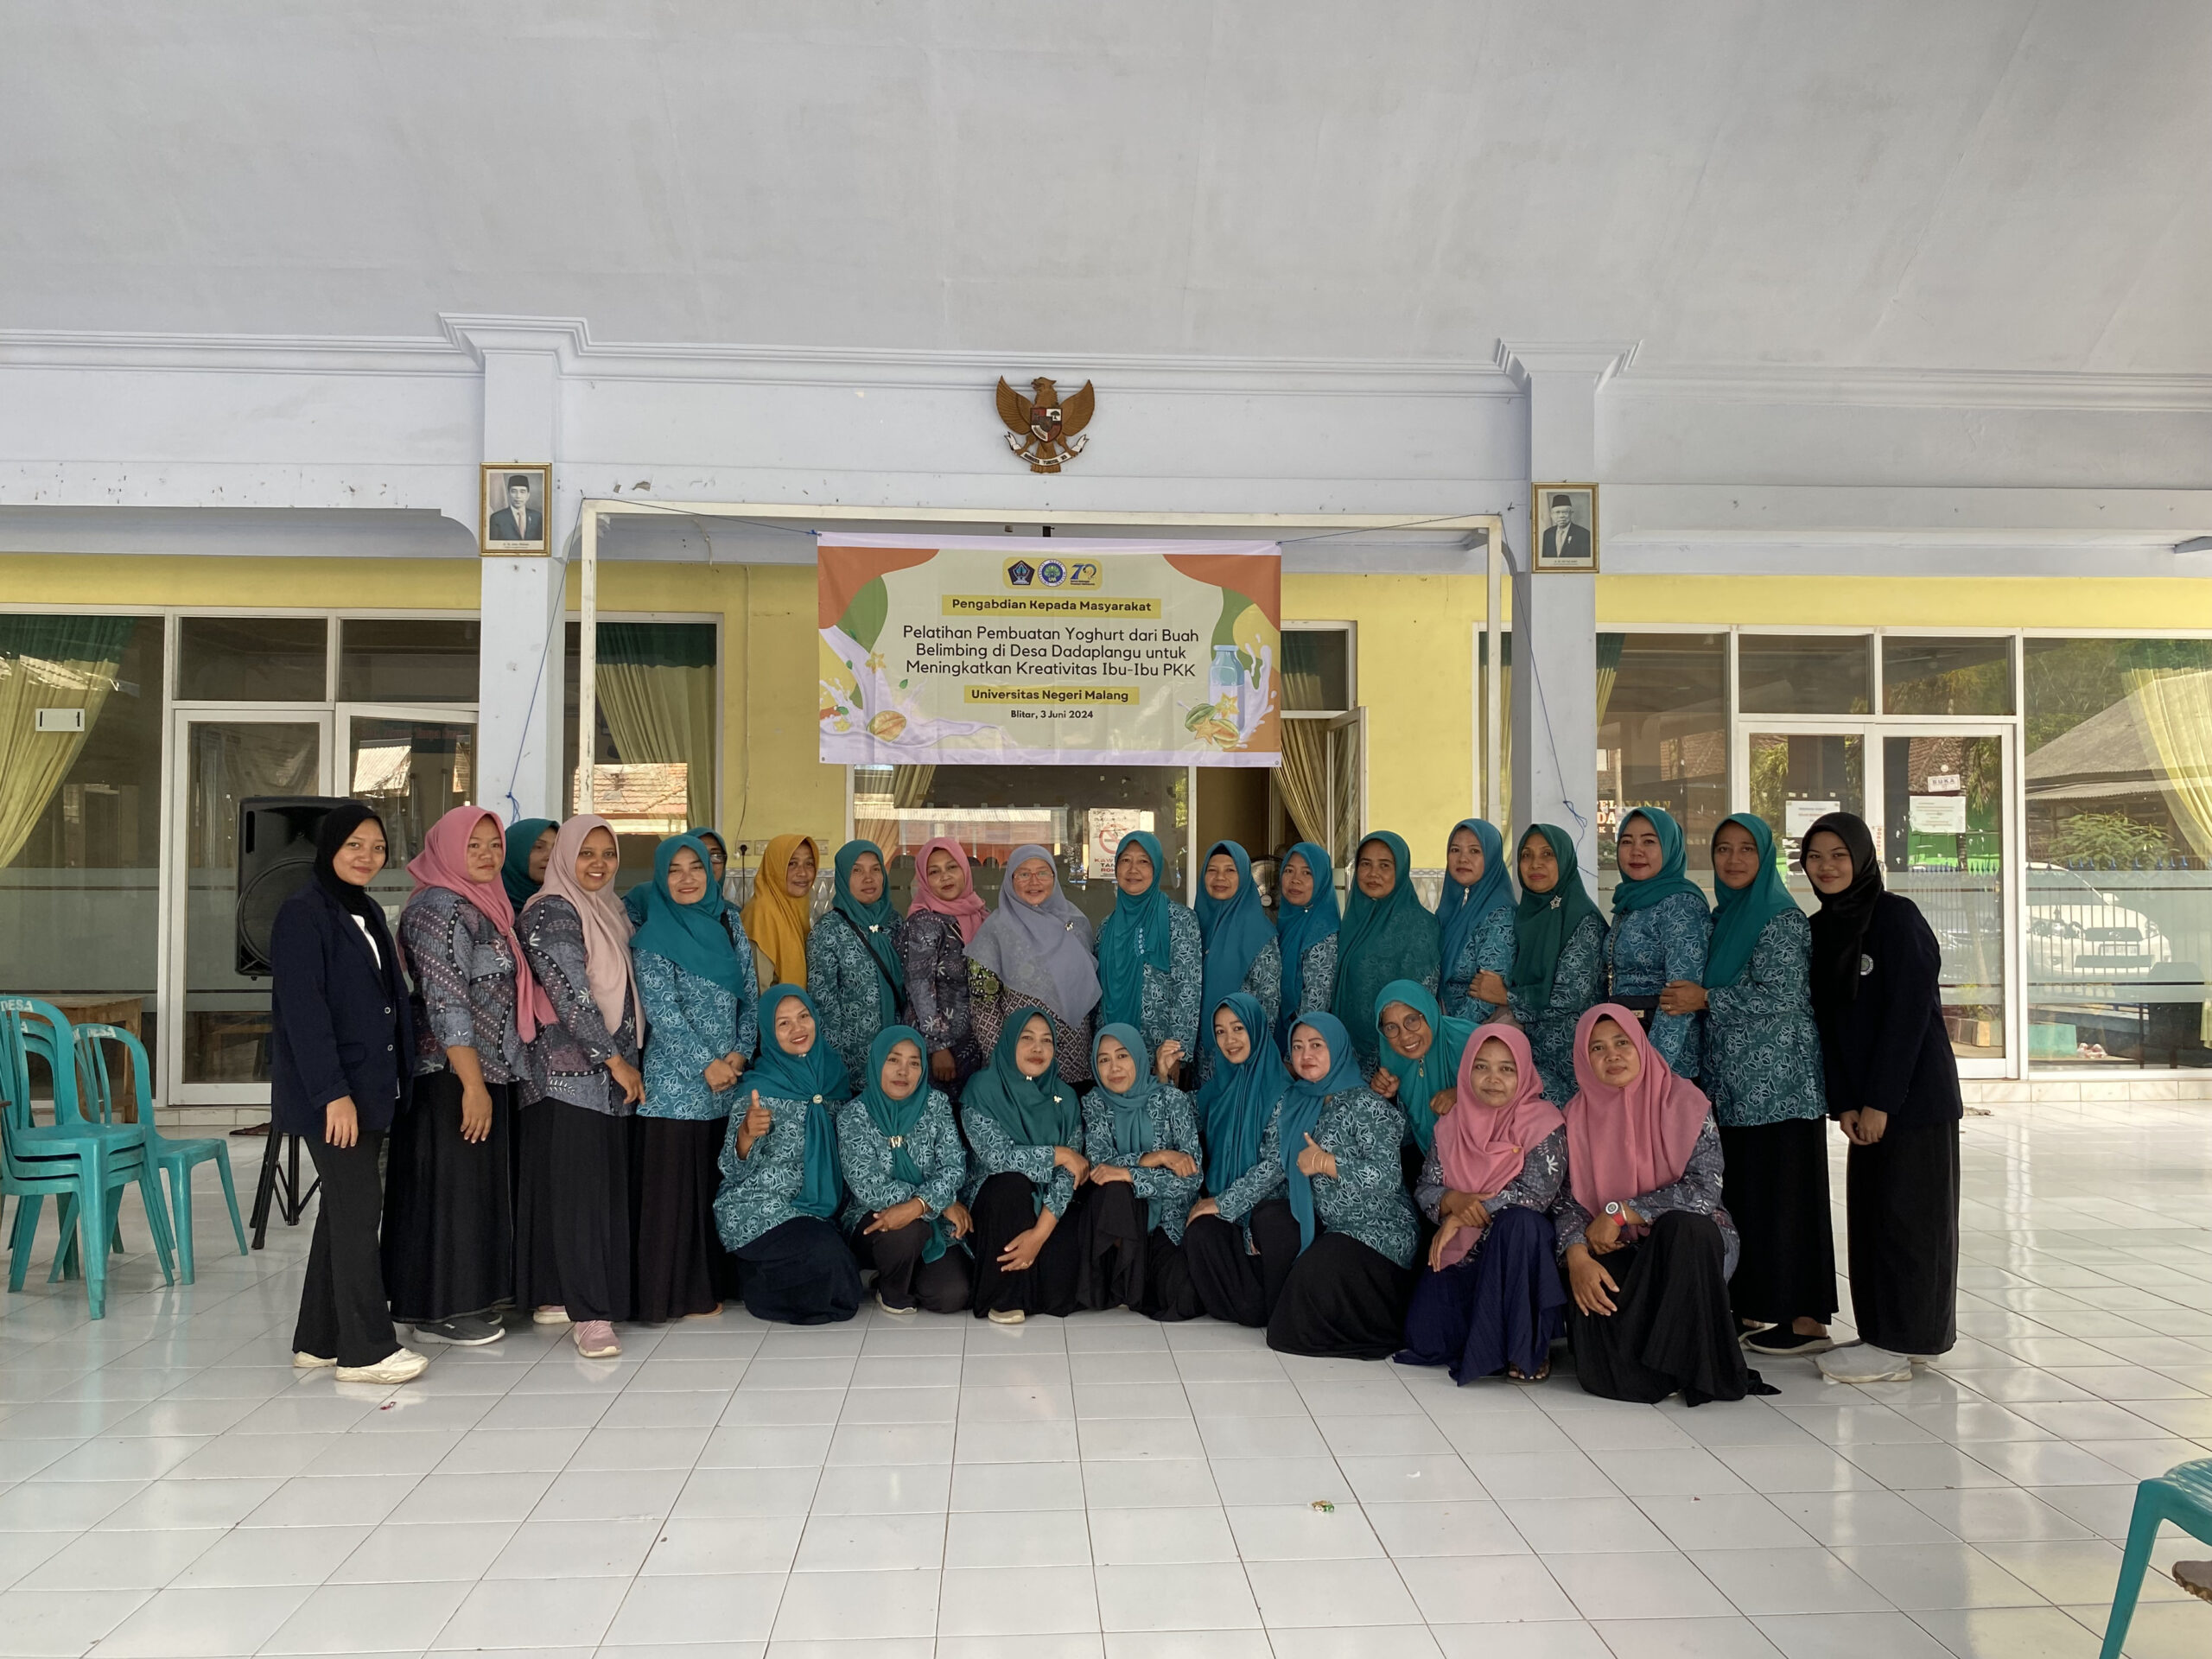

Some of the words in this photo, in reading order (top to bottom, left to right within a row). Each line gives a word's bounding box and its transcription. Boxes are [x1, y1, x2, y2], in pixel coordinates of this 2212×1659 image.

[952, 599, 1027, 611] Pengabdian
[1029, 600, 1077, 612] Kepada
[1079, 601, 1152, 613] Masyarakat
[903, 625, 972, 639] Pelatihan
[976, 626, 1060, 639] Pembuatan
[1065, 626, 1125, 643] Yoghurt
[1128, 628, 1158, 642] dari
[1161, 628, 1199, 642] Buah
[916, 643, 988, 659] Belimbing
[993, 644, 1006, 657] di
[1010, 644, 1047, 658] Desa
[1052, 644, 1141, 661] Dadaplangu
[1146, 645, 1187, 659] untuk
[906, 659, 1012, 677] Meningkatkan
[1016, 661, 1097, 675] Kreativitas
[1102, 662, 1159, 676] Ibu-Ibu
[1163, 663, 1196, 677] PKK
[971, 690, 1039, 699] Universitas
[1042, 690, 1082, 702] Negeri
[1084, 690, 1128, 702] Malang
[1011, 709, 1038, 719] Blitar,
[1039, 710, 1046, 719] 3
[1047, 710, 1066, 719] Juni
[1068, 710, 1094, 719] 2024
